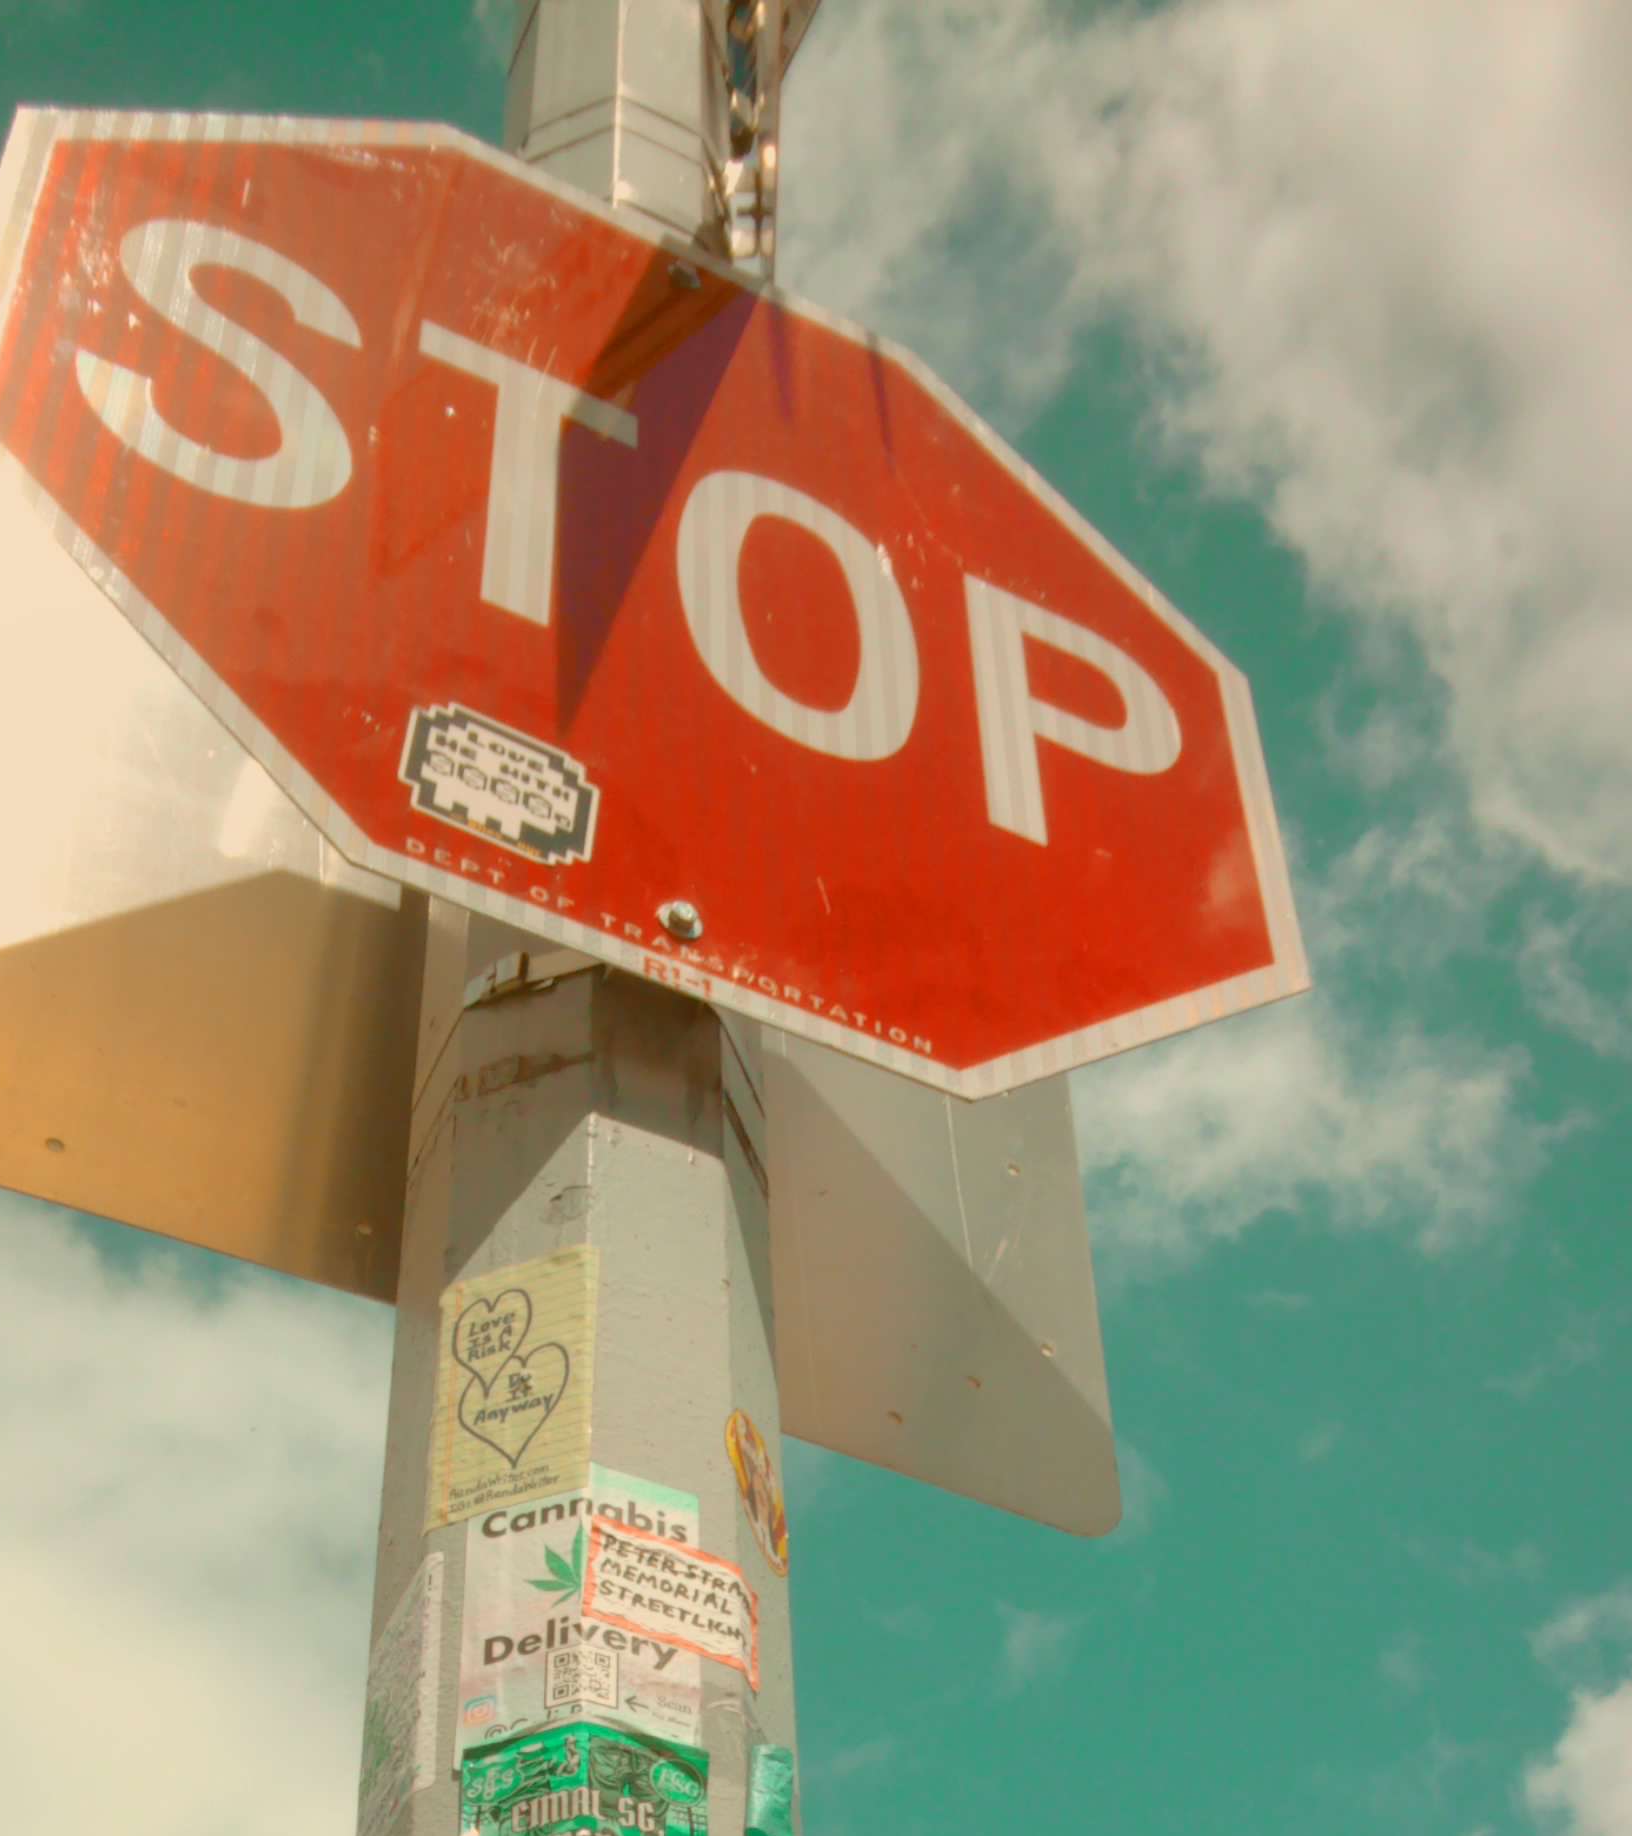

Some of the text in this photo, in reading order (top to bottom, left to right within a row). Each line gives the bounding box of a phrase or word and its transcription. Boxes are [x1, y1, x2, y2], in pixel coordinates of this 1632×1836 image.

[75, 218, 1182, 846] STOP
[468, 730, 544, 773] LOVE
[405, 836, 935, 1055] DEPT OF TRANSPORTATION
[473, 1393, 555, 1426] Anyway
[481, 1497, 688, 1543] Cannabis
[601, 1533, 678, 1576] PETER
[600, 1557, 733, 1616] MEMORIAL
[483, 1615, 678, 1671] Delivery
